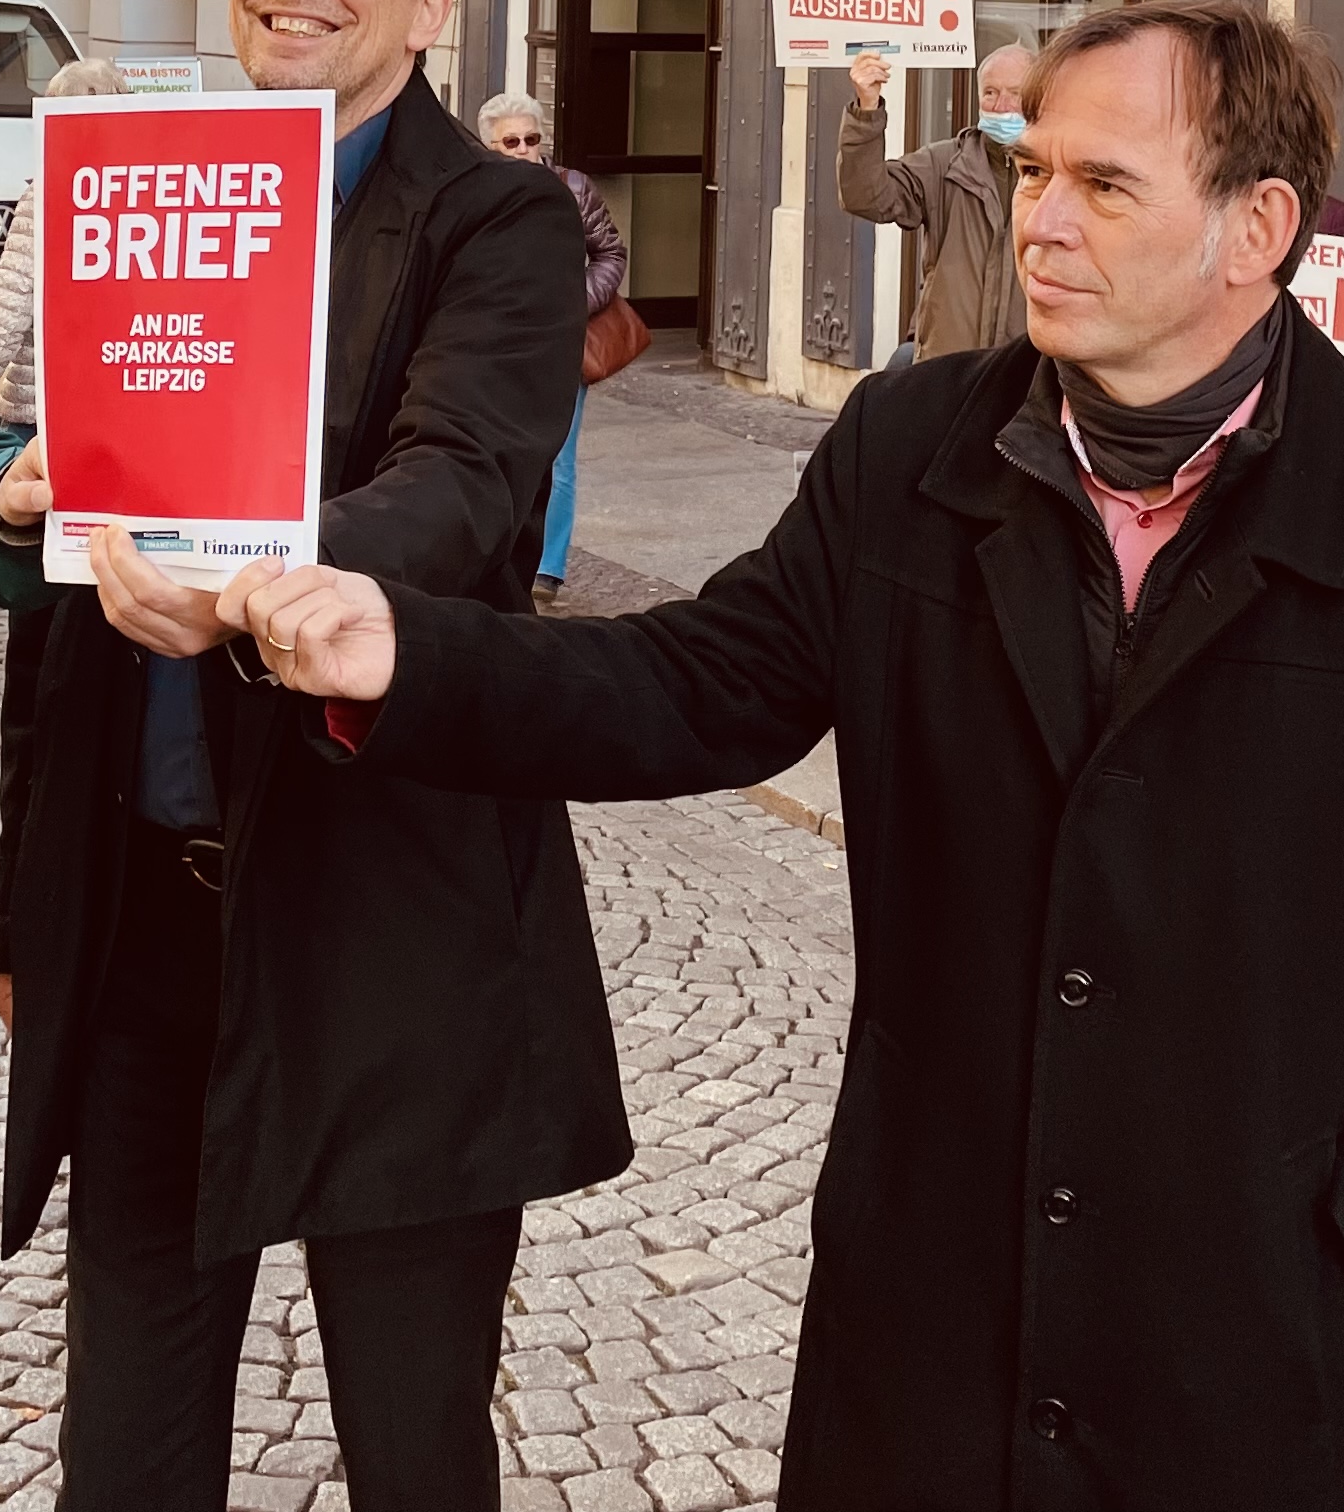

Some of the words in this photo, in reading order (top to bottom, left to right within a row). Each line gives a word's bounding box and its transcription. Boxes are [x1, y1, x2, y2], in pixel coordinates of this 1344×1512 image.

[912, 42, 968, 55] Finanztip
[122, 68, 147, 78] ASIA
[150, 68, 191, 78] BISTRO
[128, 84, 192, 92] UPERMARKT
[71, 163, 283, 209] OFFENER
[71, 212, 282, 280] BRIEF
[129, 314, 162, 337] AN
[166, 313, 204, 337] DIE
[101, 341, 235, 365] SPARKASSE
[122, 368, 206, 392] LEIPZIG
[203, 539, 290, 559] Finanztip
